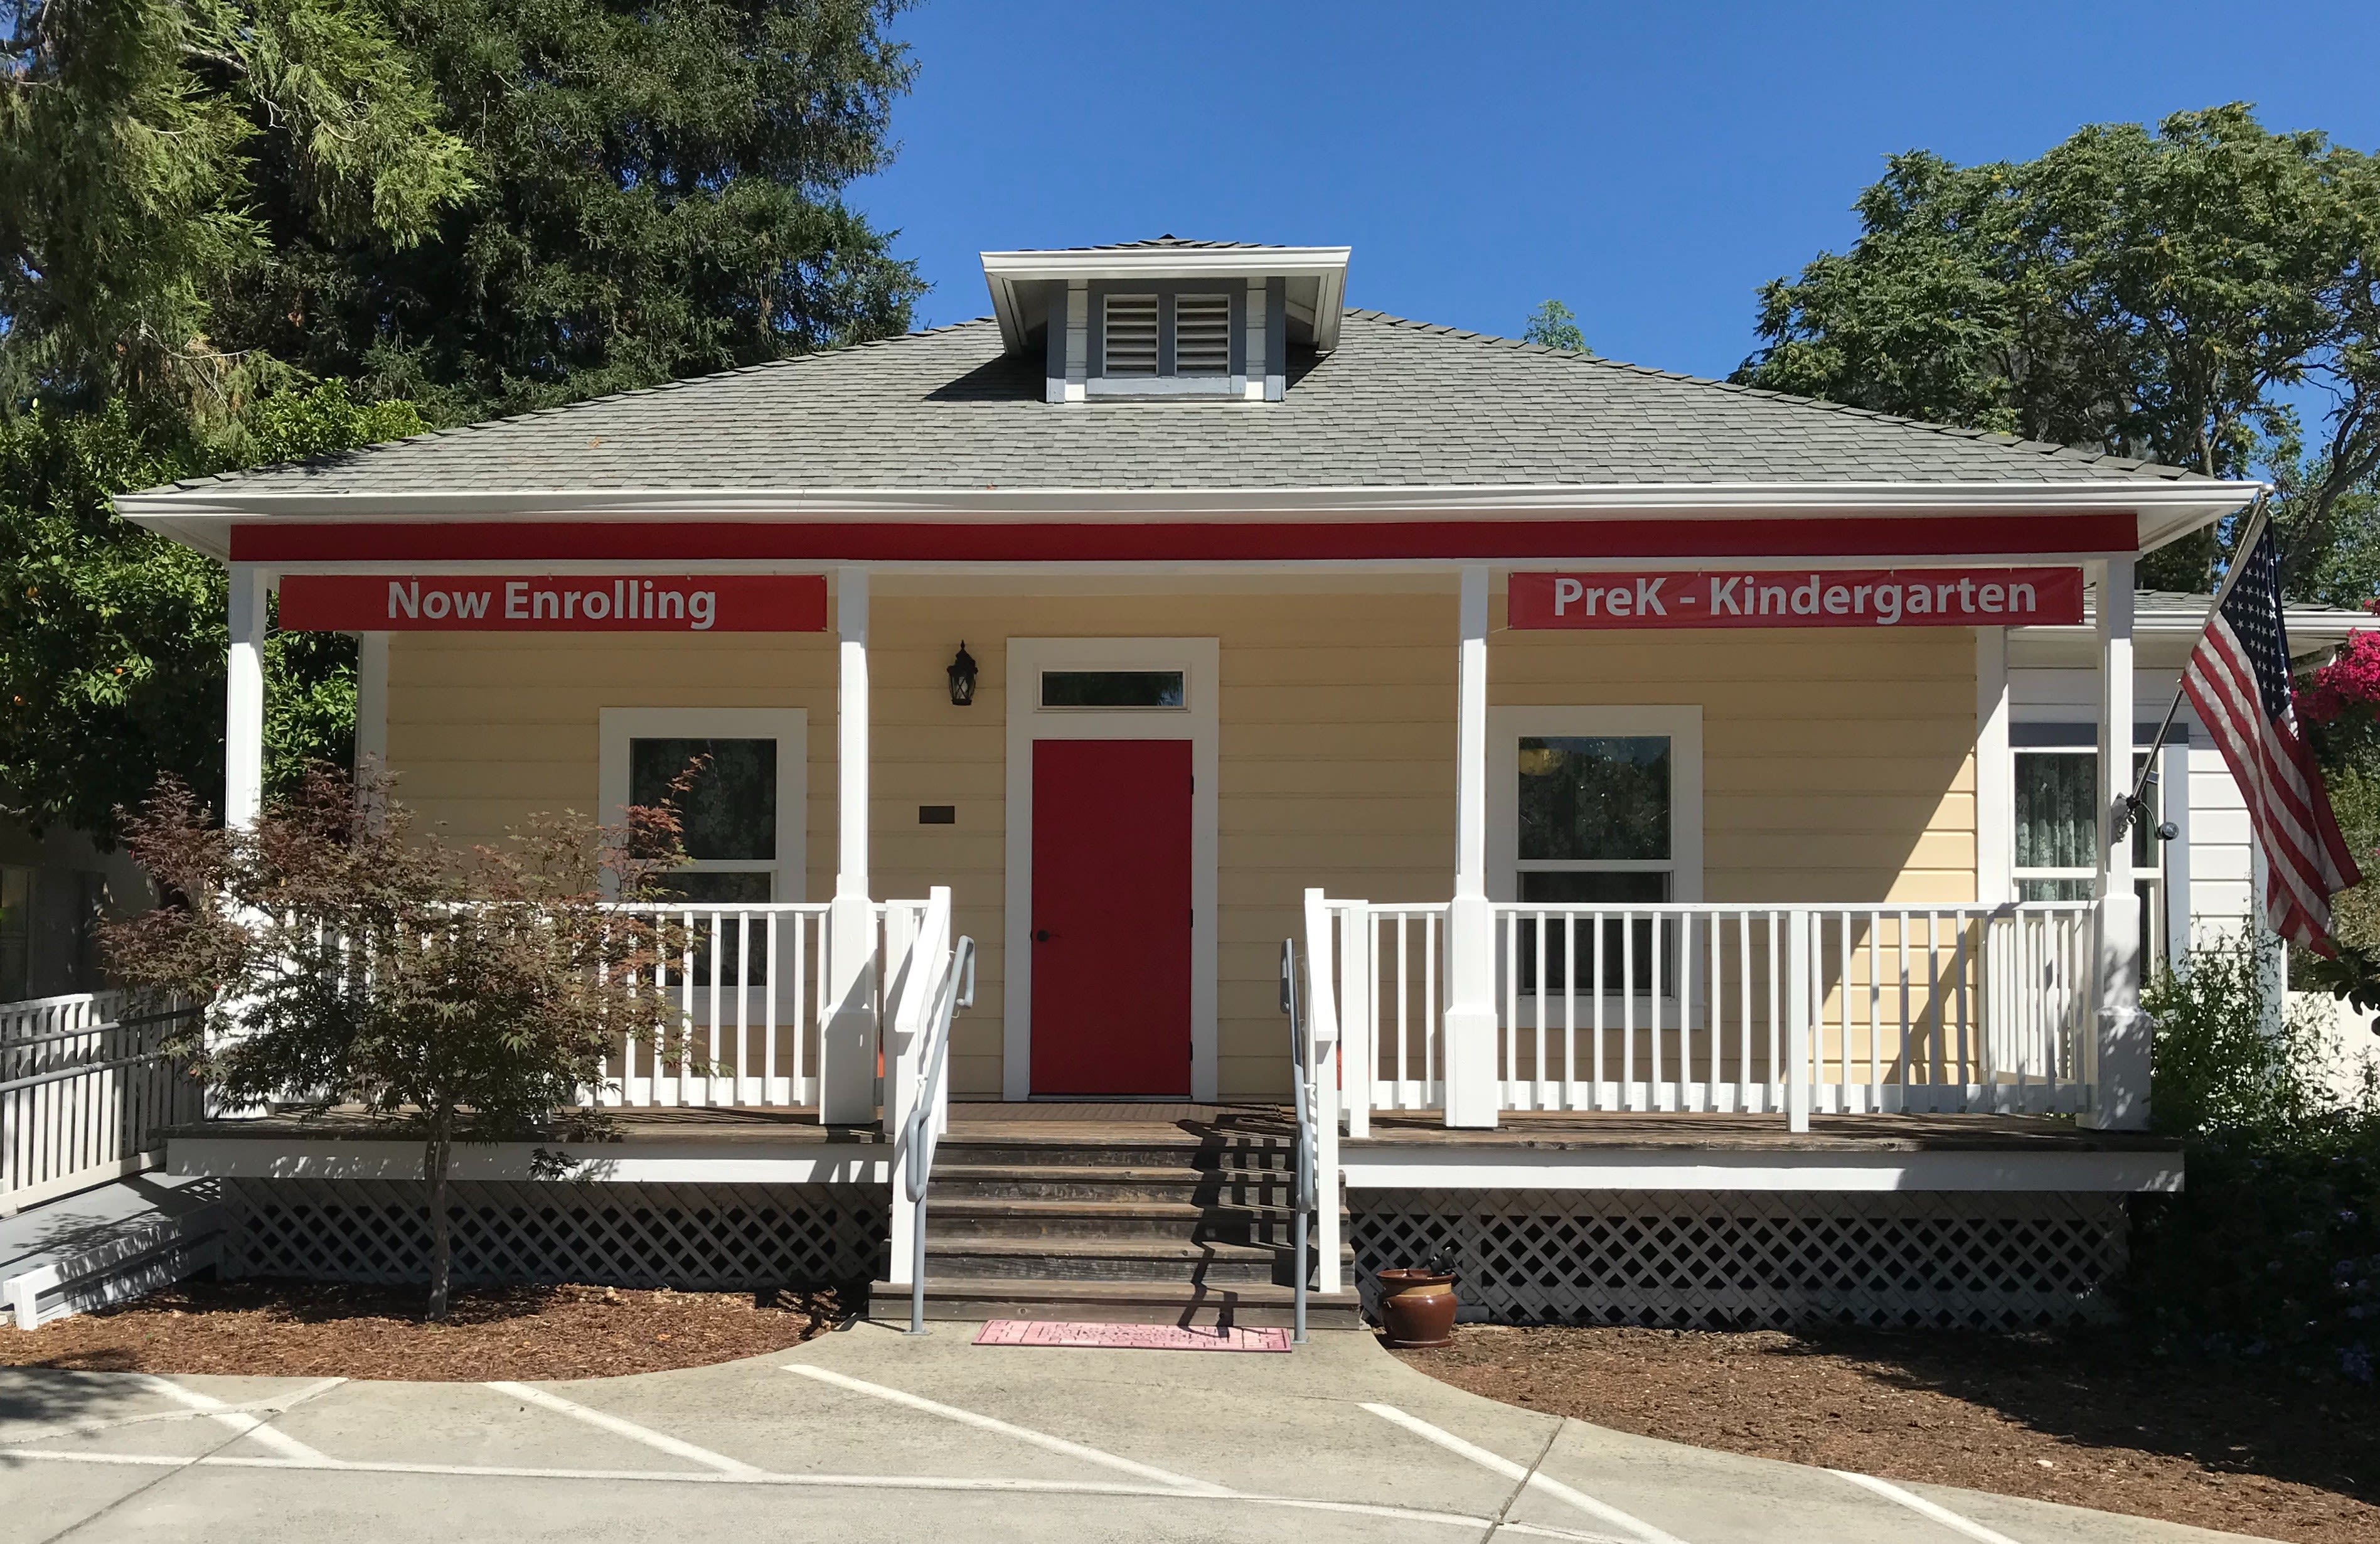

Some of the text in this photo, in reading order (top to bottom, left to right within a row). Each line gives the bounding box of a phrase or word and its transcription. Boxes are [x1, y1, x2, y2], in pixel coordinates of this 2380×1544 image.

[388, 580, 716, 630] Now Enrolling
[1554, 577, 1668, 616] PreK
[1710, 574, 2036, 623] Kindergarten
